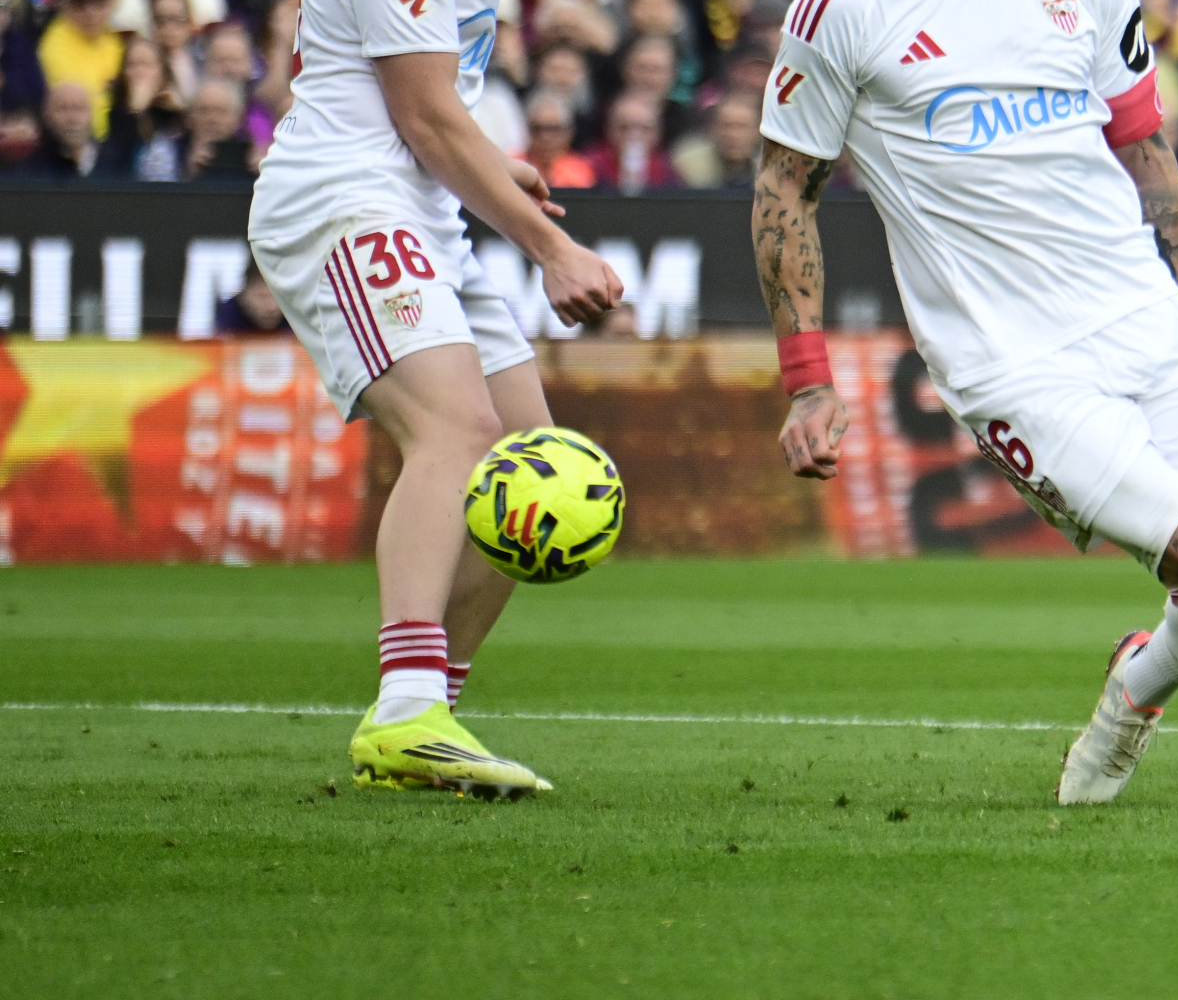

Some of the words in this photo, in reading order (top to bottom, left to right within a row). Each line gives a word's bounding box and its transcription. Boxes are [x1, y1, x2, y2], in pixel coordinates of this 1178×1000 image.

[925, 86, 1089, 153] Midea
[353, 229, 436, 290] 36
[987, 420, 1034, 480] 6
